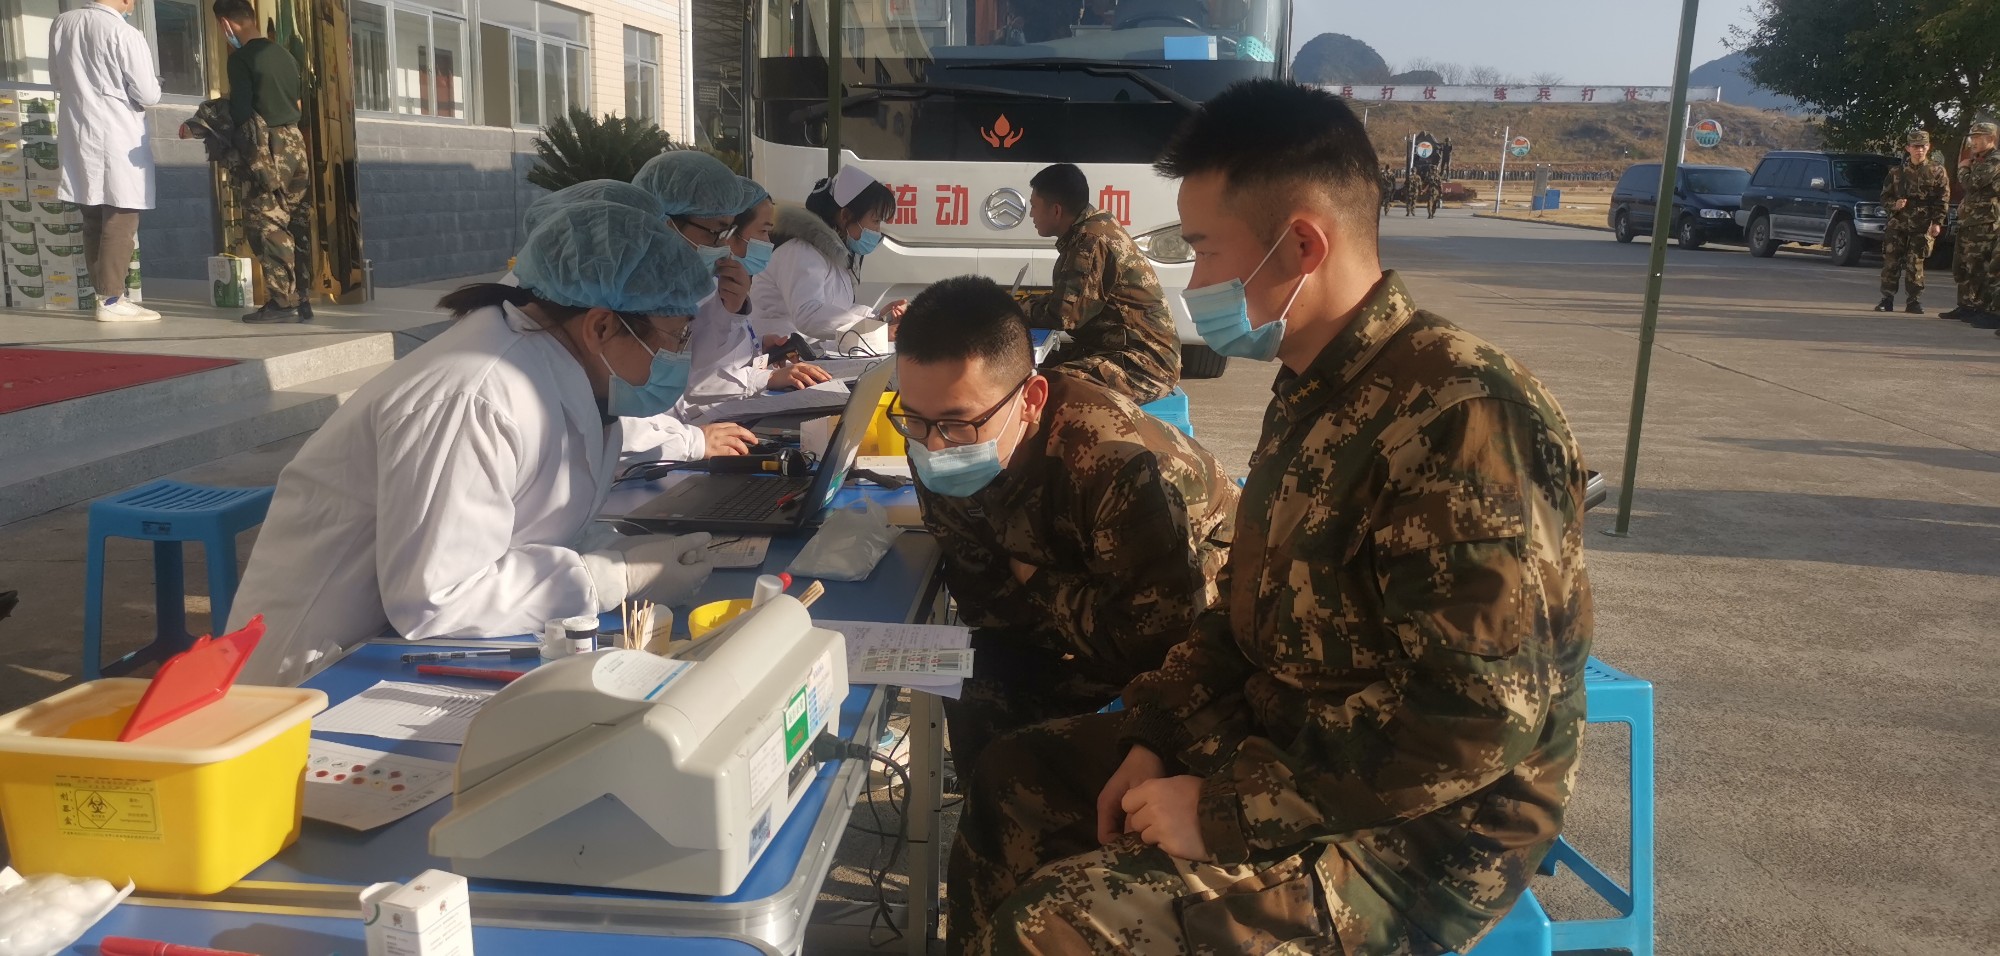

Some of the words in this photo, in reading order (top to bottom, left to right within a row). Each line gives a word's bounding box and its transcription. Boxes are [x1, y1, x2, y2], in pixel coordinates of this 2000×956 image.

[1304, 84, 1437, 100] 兵打仗
[1494, 86, 1639, 101] 练兵打仗
[885, 184, 969, 225] 流动
[1099, 184, 1131, 226] 血
